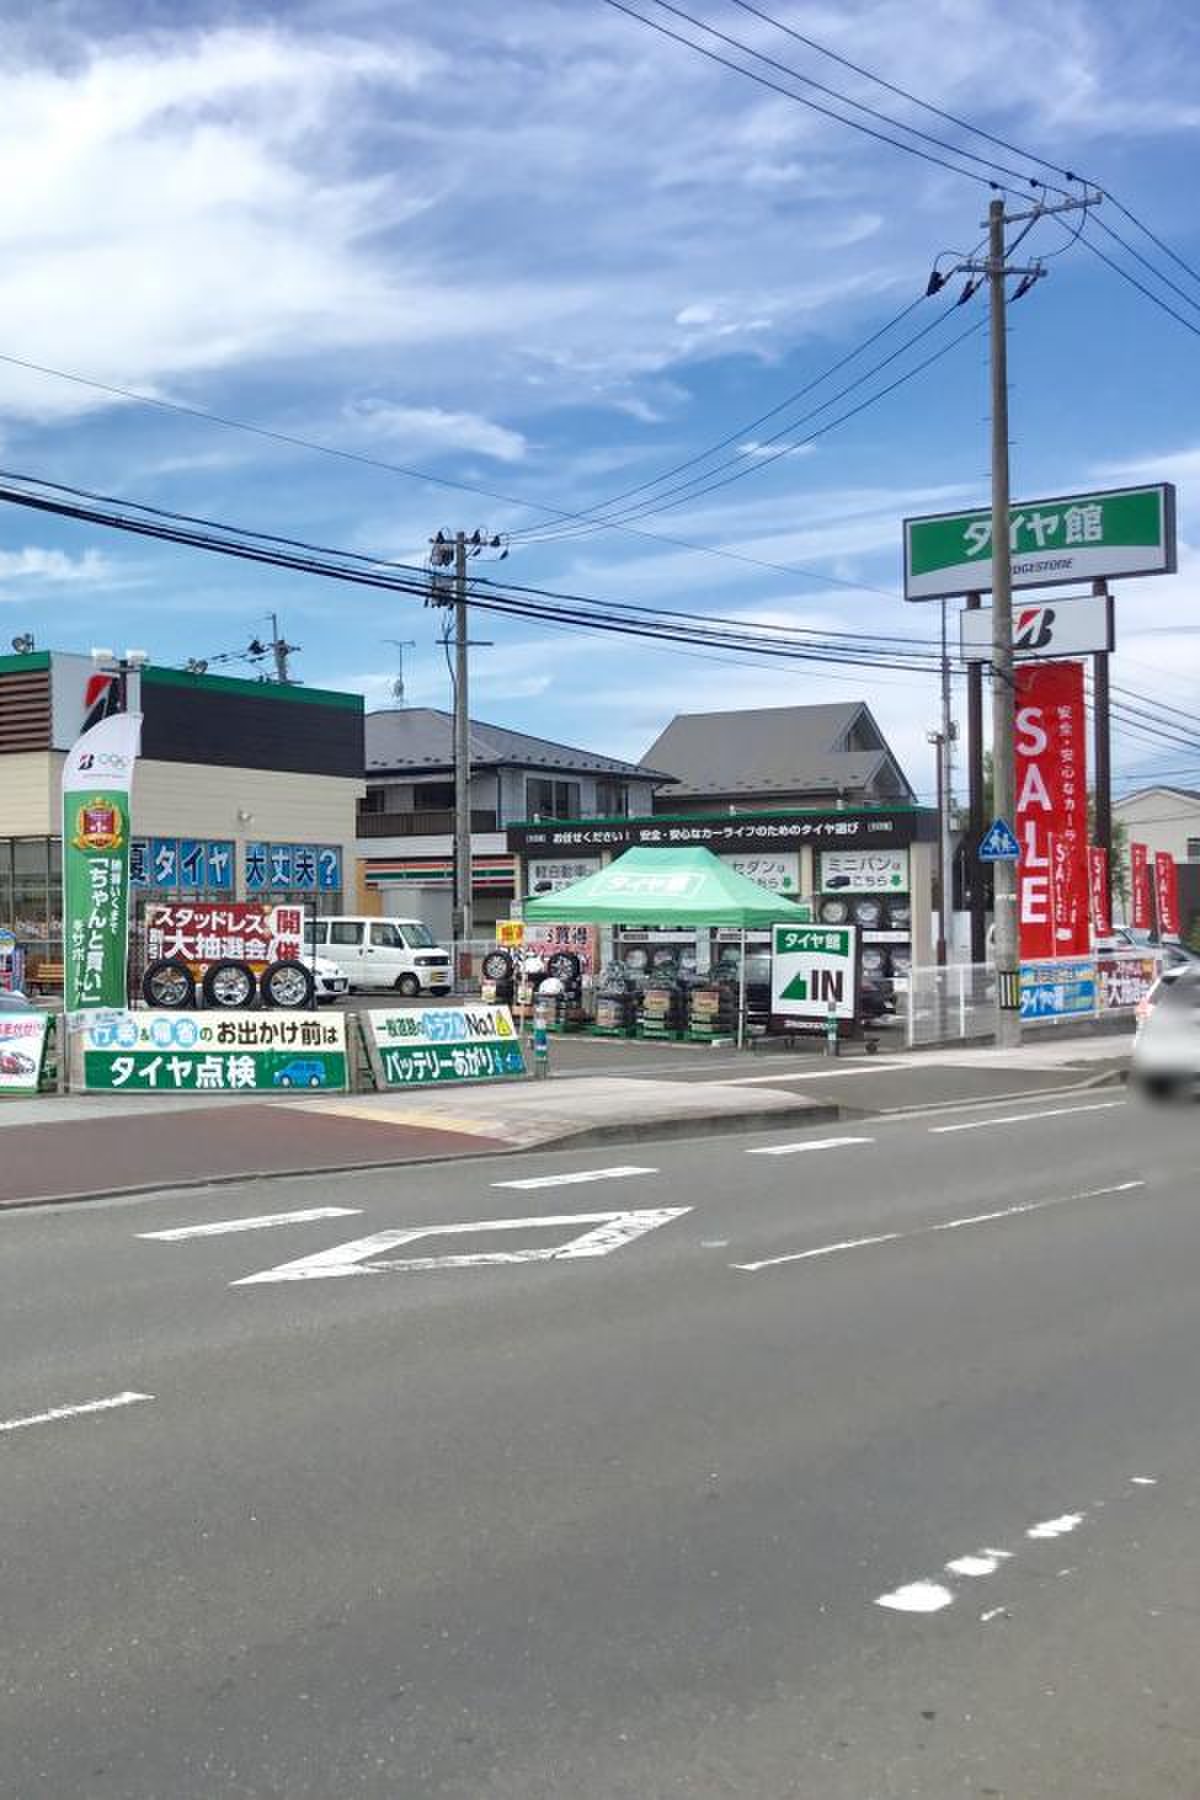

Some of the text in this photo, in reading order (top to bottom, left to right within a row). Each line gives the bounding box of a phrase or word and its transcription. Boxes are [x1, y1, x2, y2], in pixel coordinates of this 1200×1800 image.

[1016, 706, 1053, 923] SALE
[853, 875, 888, 887] こちら
[155, 907, 265, 934] スタッドレス
[164, 929, 268, 961] 大抽選会
[784, 933, 841, 951] タイヤ館
[811, 969, 844, 1002] IN
[110, 1055, 257, 1088] タイヤ点検
[386, 1045, 495, 1081] バッテリーあがり
